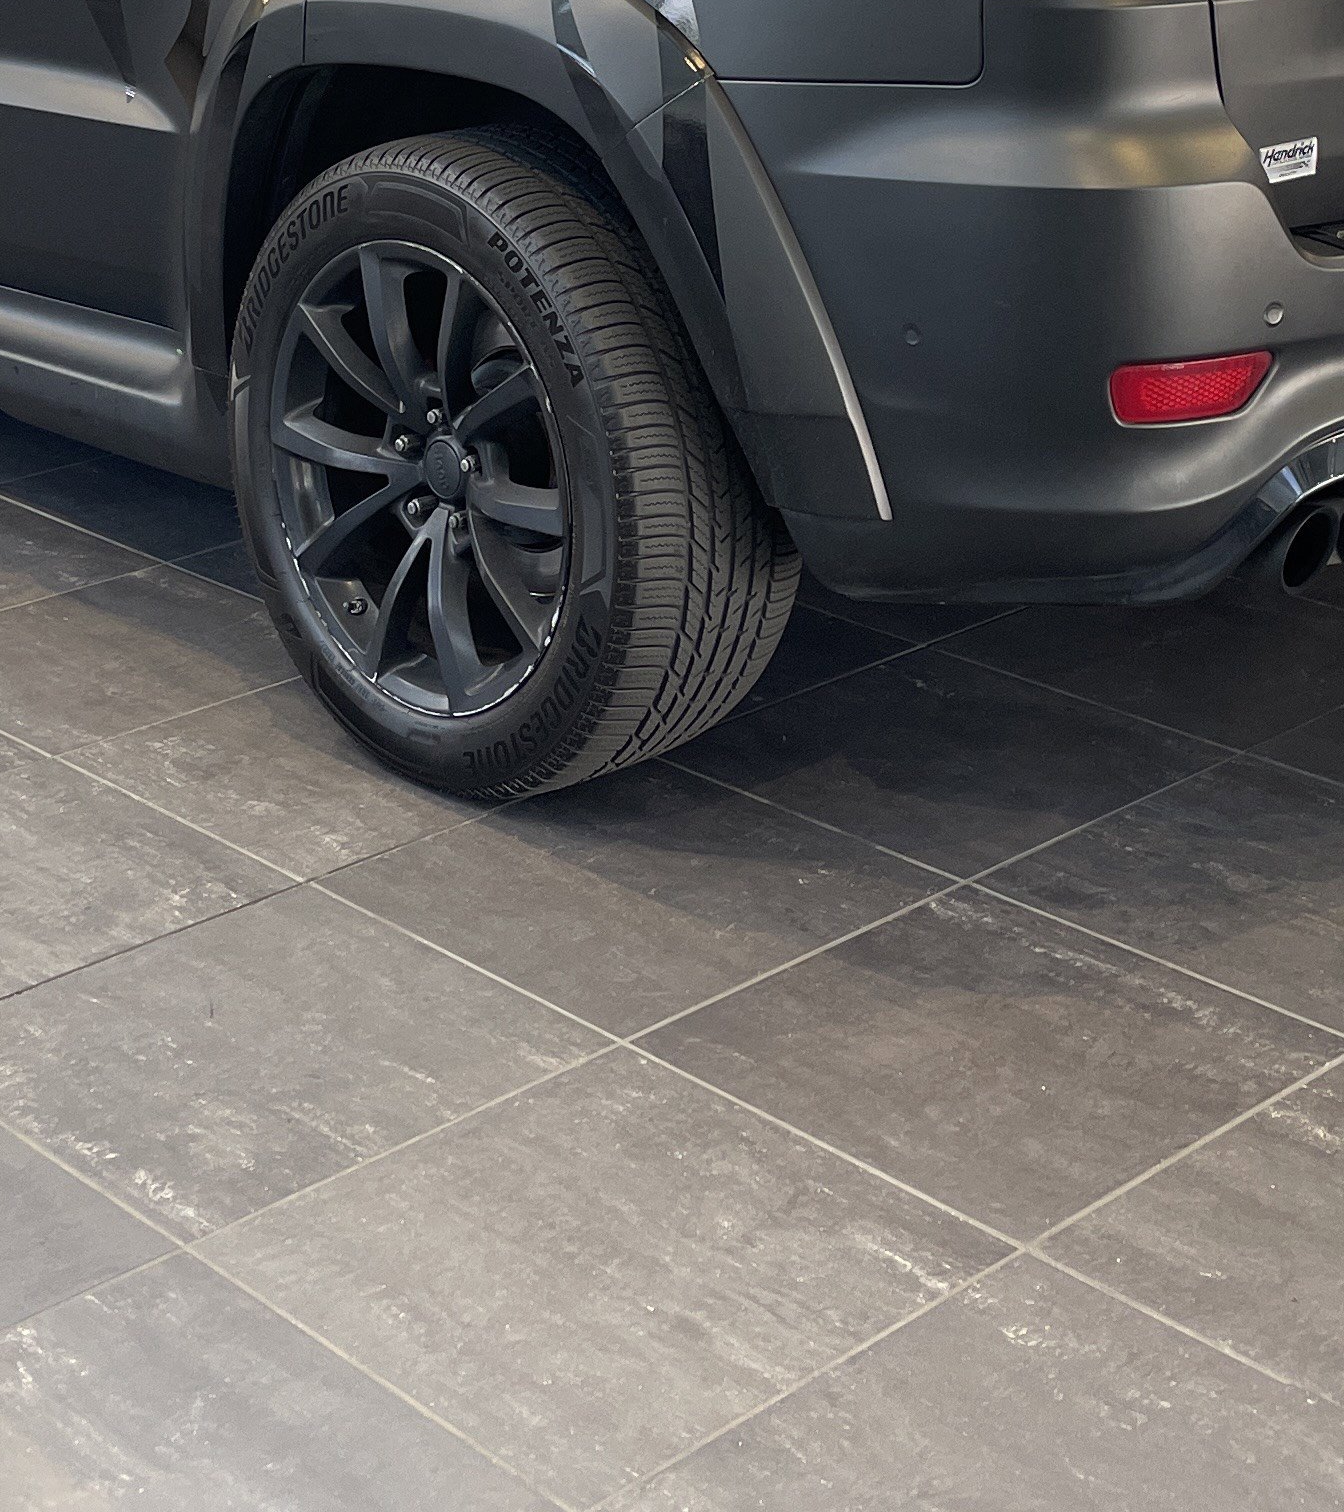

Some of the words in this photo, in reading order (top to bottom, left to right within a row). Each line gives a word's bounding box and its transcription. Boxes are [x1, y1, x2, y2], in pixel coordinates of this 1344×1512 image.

[1263, 140, 1315, 167] Hendrick
[238, 183, 350, 355] BRIDGESTONE
[487, 231, 584, 388] POTENZA
[463, 615, 602, 777] BRIDGESTONE
